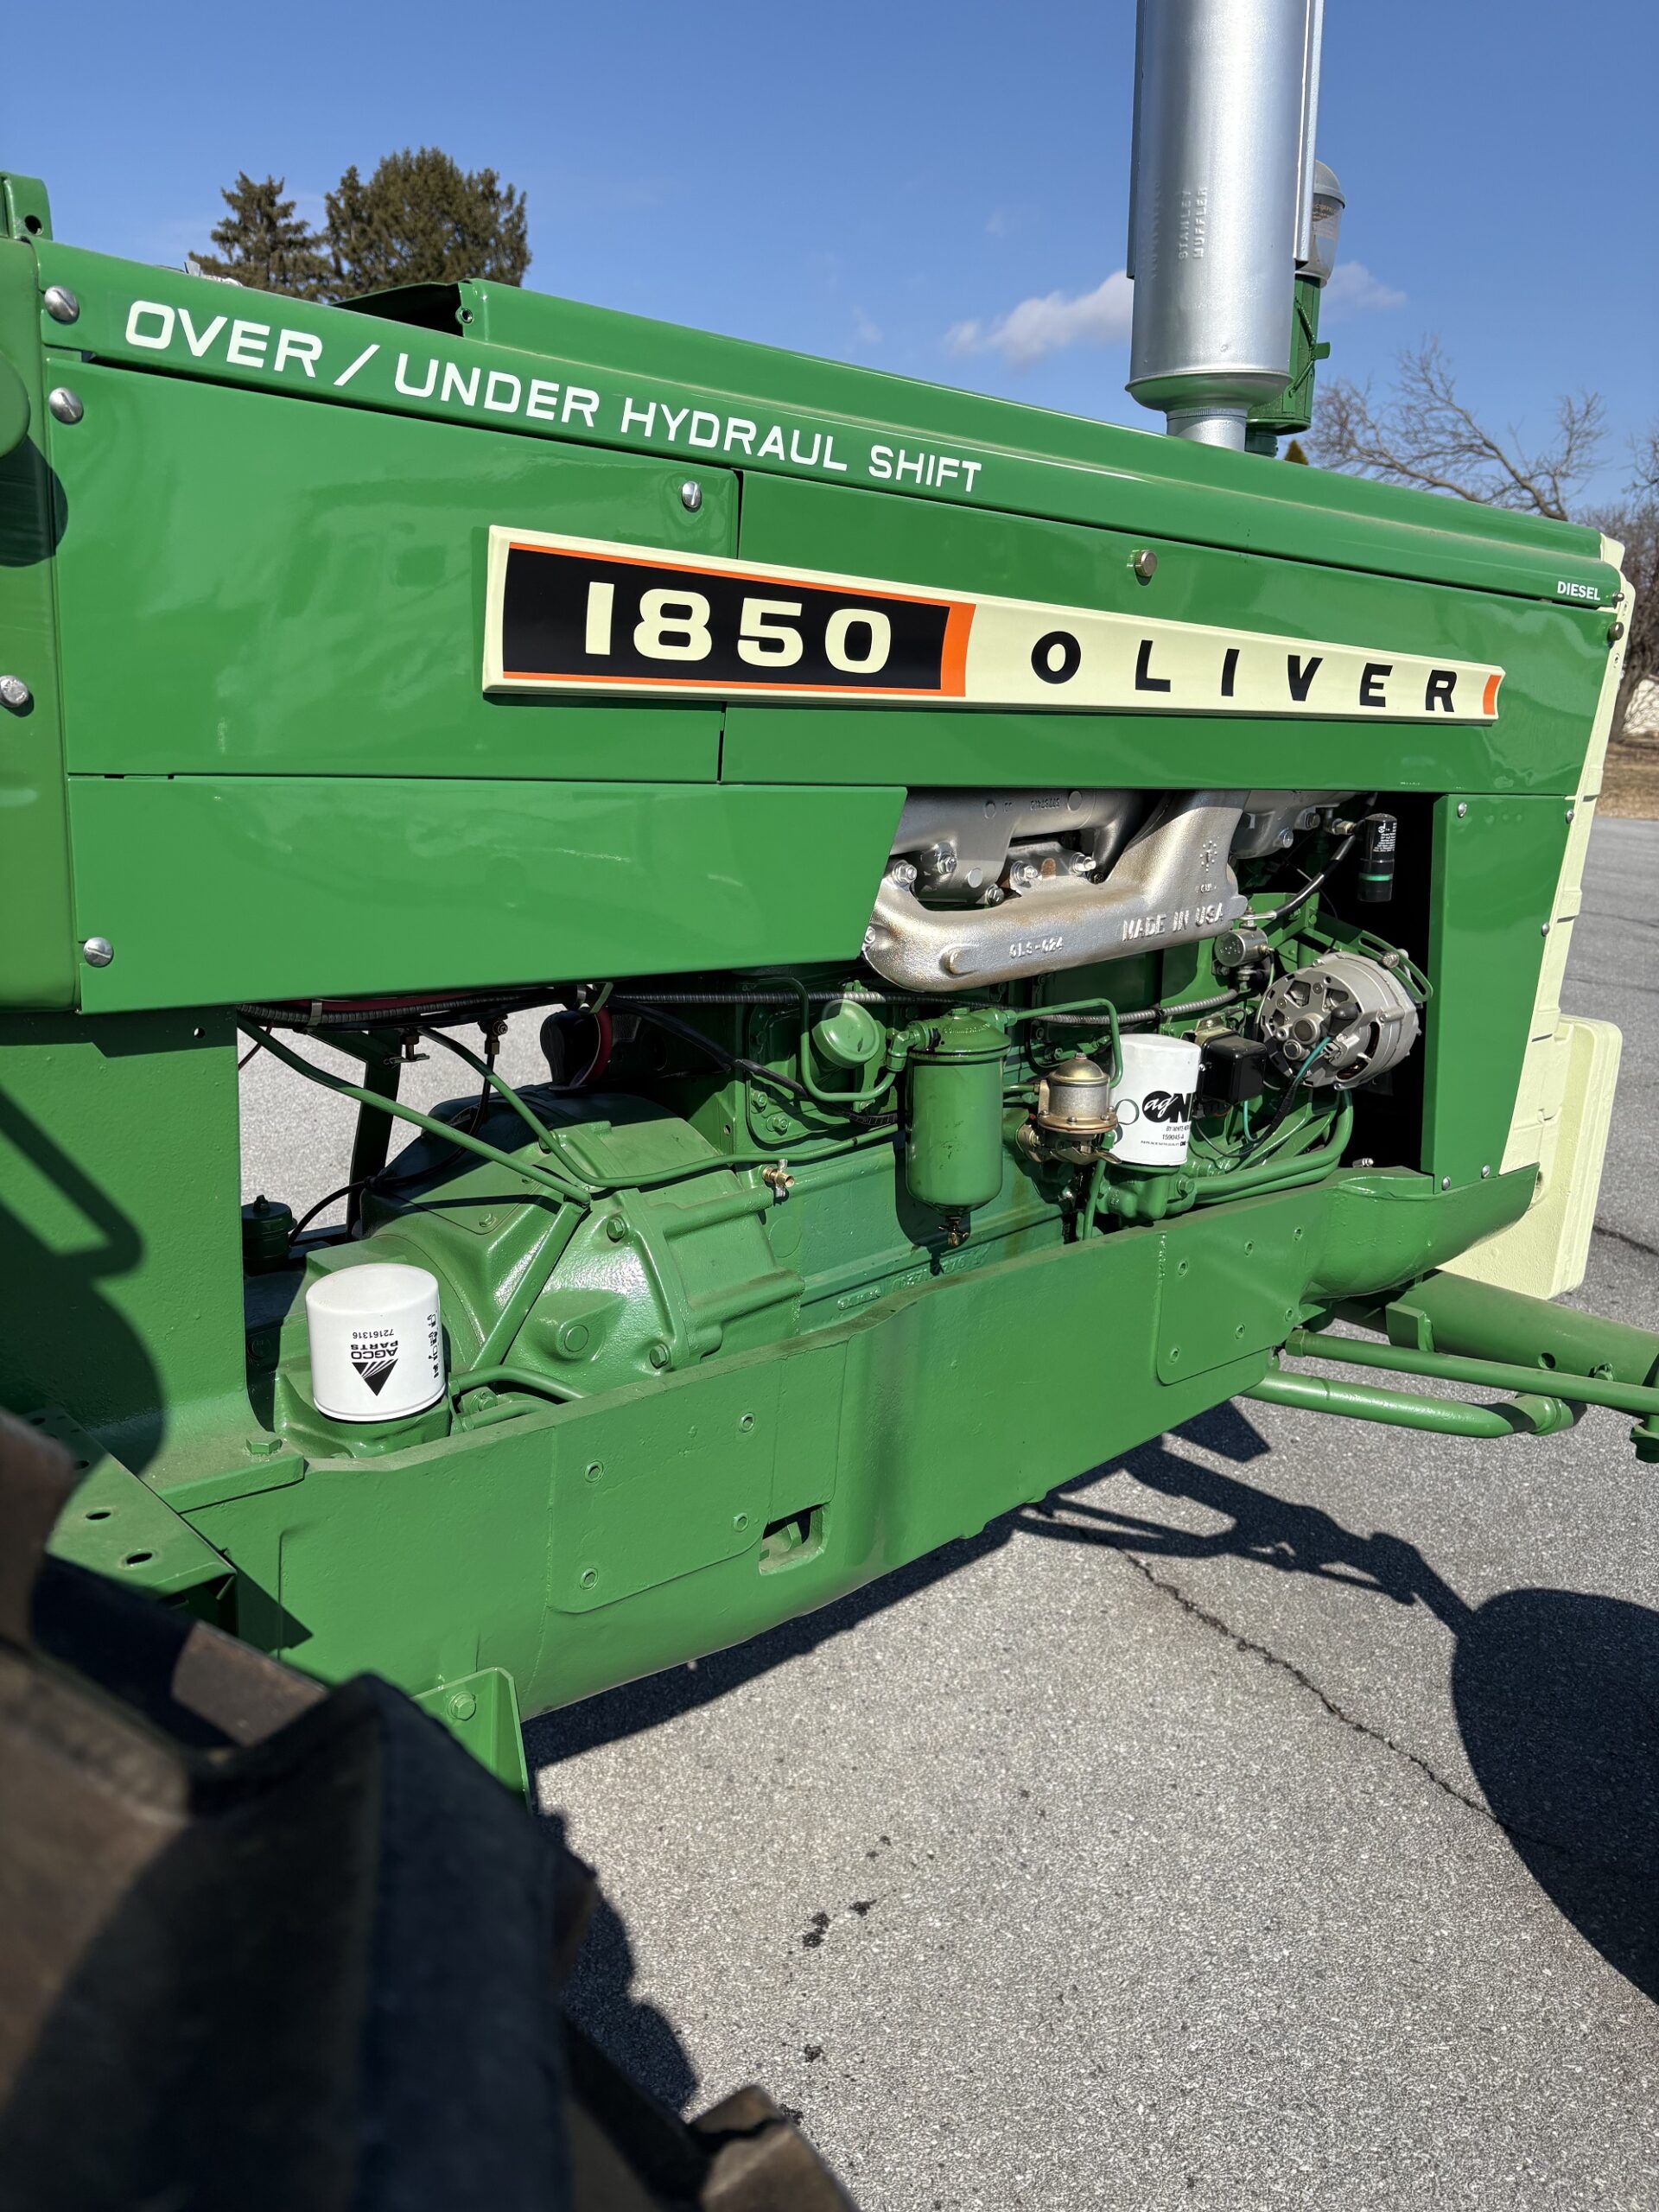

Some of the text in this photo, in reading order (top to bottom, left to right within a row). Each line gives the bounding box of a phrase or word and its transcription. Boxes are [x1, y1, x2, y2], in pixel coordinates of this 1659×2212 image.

[1178, 189, 1192, 260] STANLEY
[1192, 186, 1208, 259] MUFFLER
[125, 301, 323, 378] OVER
[395, 353, 600, 428] UNDER
[620, 397, 848, 471] HYDRAUL
[868, 444, 982, 493] SHIFT
[1557, 581, 1601, 601] DIESEL
[584, 581, 892, 675] 1850
[1031, 630, 1459, 713] OLIVER
[1122, 902, 1224, 942] MADE IN USA
[350, 1339, 399, 1351] PARTS
[350, 1346, 398, 1360] AGCO
[352, 1328, 394, 1339] 72161316
